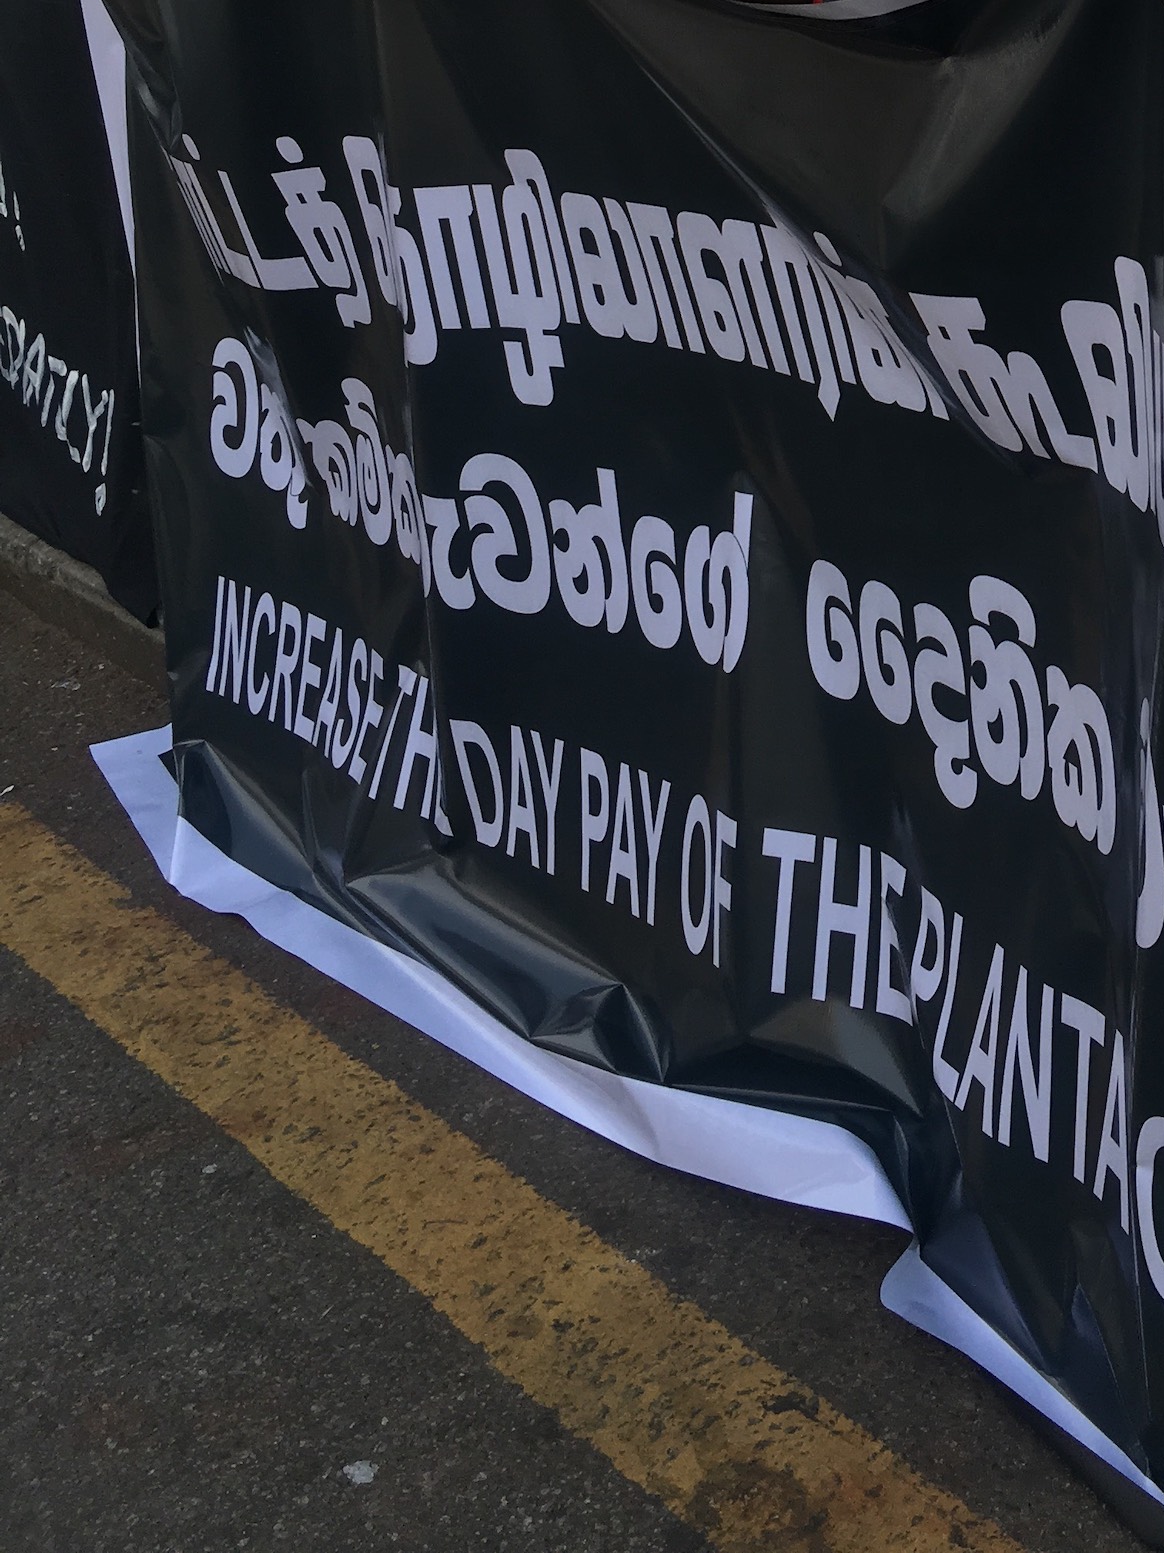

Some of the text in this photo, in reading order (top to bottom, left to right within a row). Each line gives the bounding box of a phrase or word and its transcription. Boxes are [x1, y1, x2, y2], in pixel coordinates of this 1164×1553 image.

[206, 575, 384, 785] INCREASE
[449, 718, 565, 877] DAY
[580, 748, 673, 925] PAY
[681, 794, 738, 968] OF
[762, 827, 908, 1028] THE
